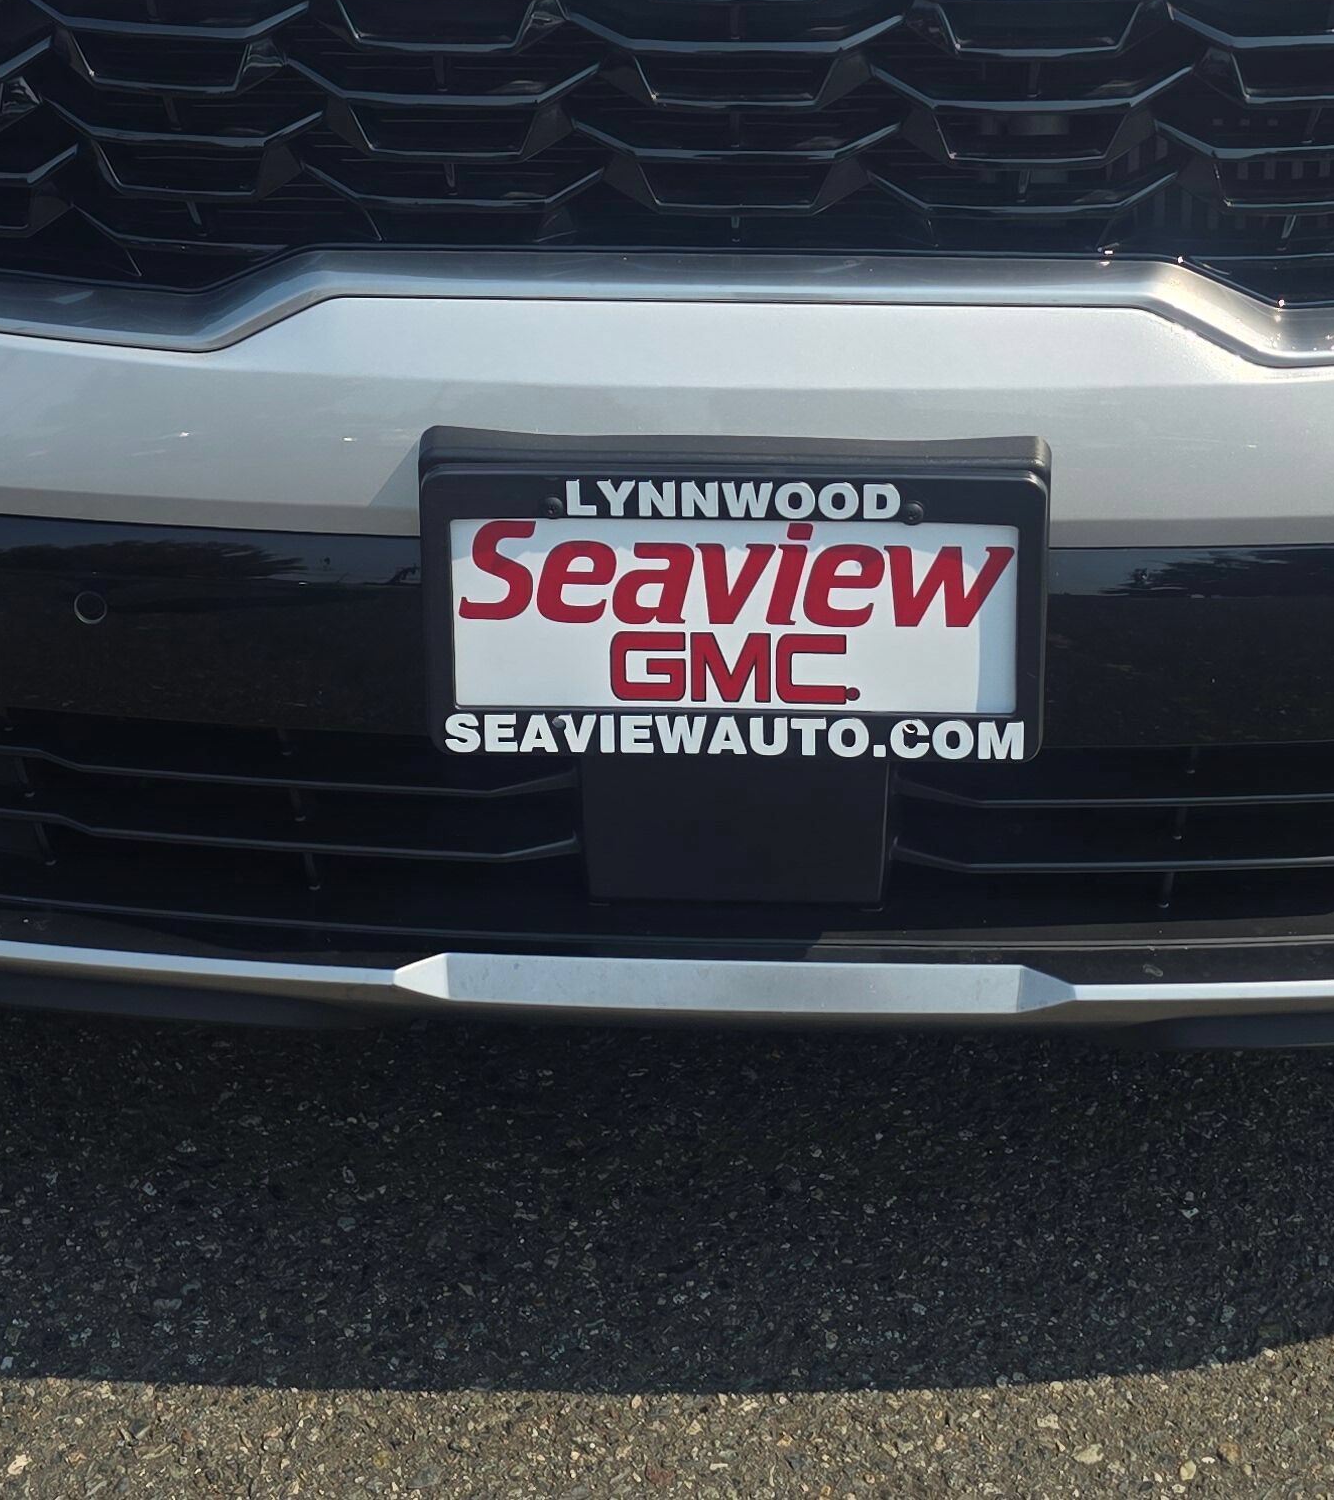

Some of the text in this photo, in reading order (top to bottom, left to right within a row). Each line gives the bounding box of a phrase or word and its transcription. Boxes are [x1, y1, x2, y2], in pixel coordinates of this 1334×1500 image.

[565, 479, 901, 520] LYNNWOOD
[458, 519, 1015, 628] Seaview
[444, 713, 1025, 761] SEAVIEWAUTO.COM
